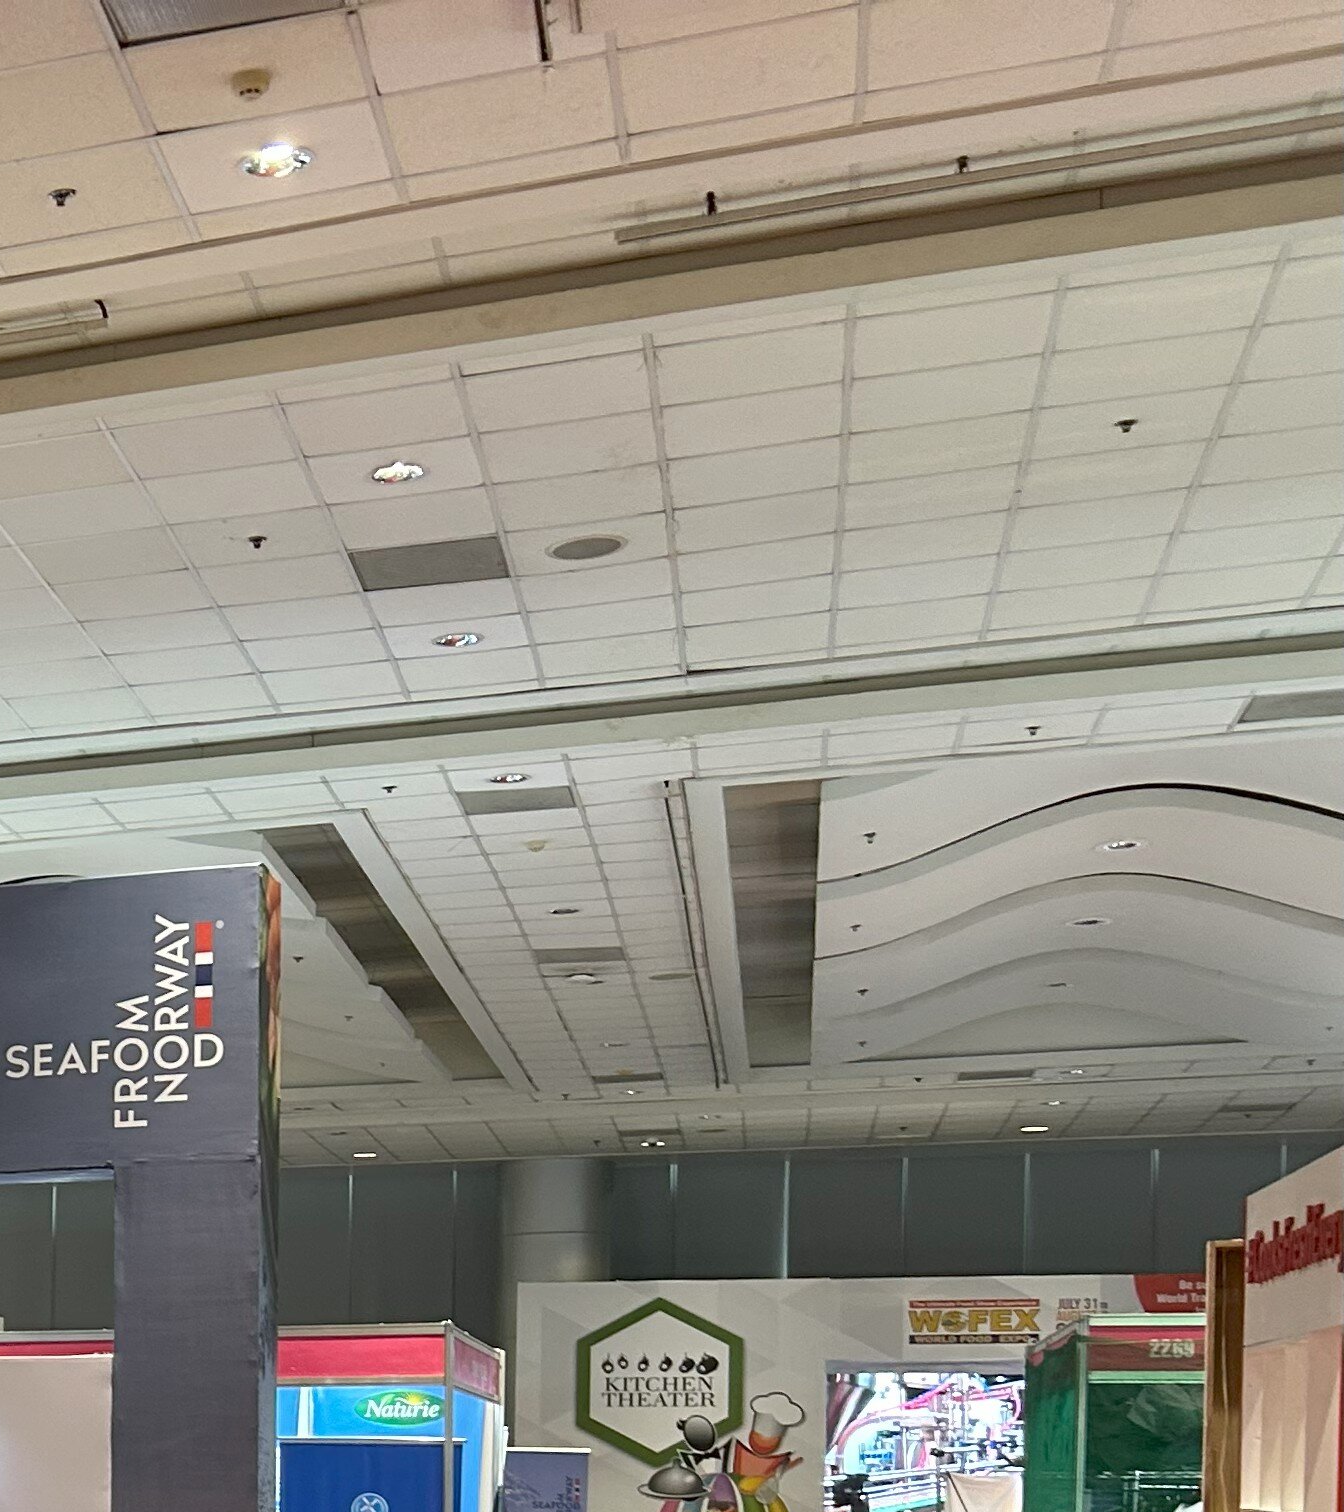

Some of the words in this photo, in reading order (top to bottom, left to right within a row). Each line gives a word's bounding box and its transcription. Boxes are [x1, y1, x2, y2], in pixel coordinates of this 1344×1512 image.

[153, 913, 190, 1103] NORWAY
[4, 1032, 225, 1079] SEAFOOD
[113, 994, 150, 1129] FROM
[602, 1392, 716, 1408] THEATER
[605, 1376, 714, 1392] KITCHEN
[364, 1396, 440, 1419] Naturie
